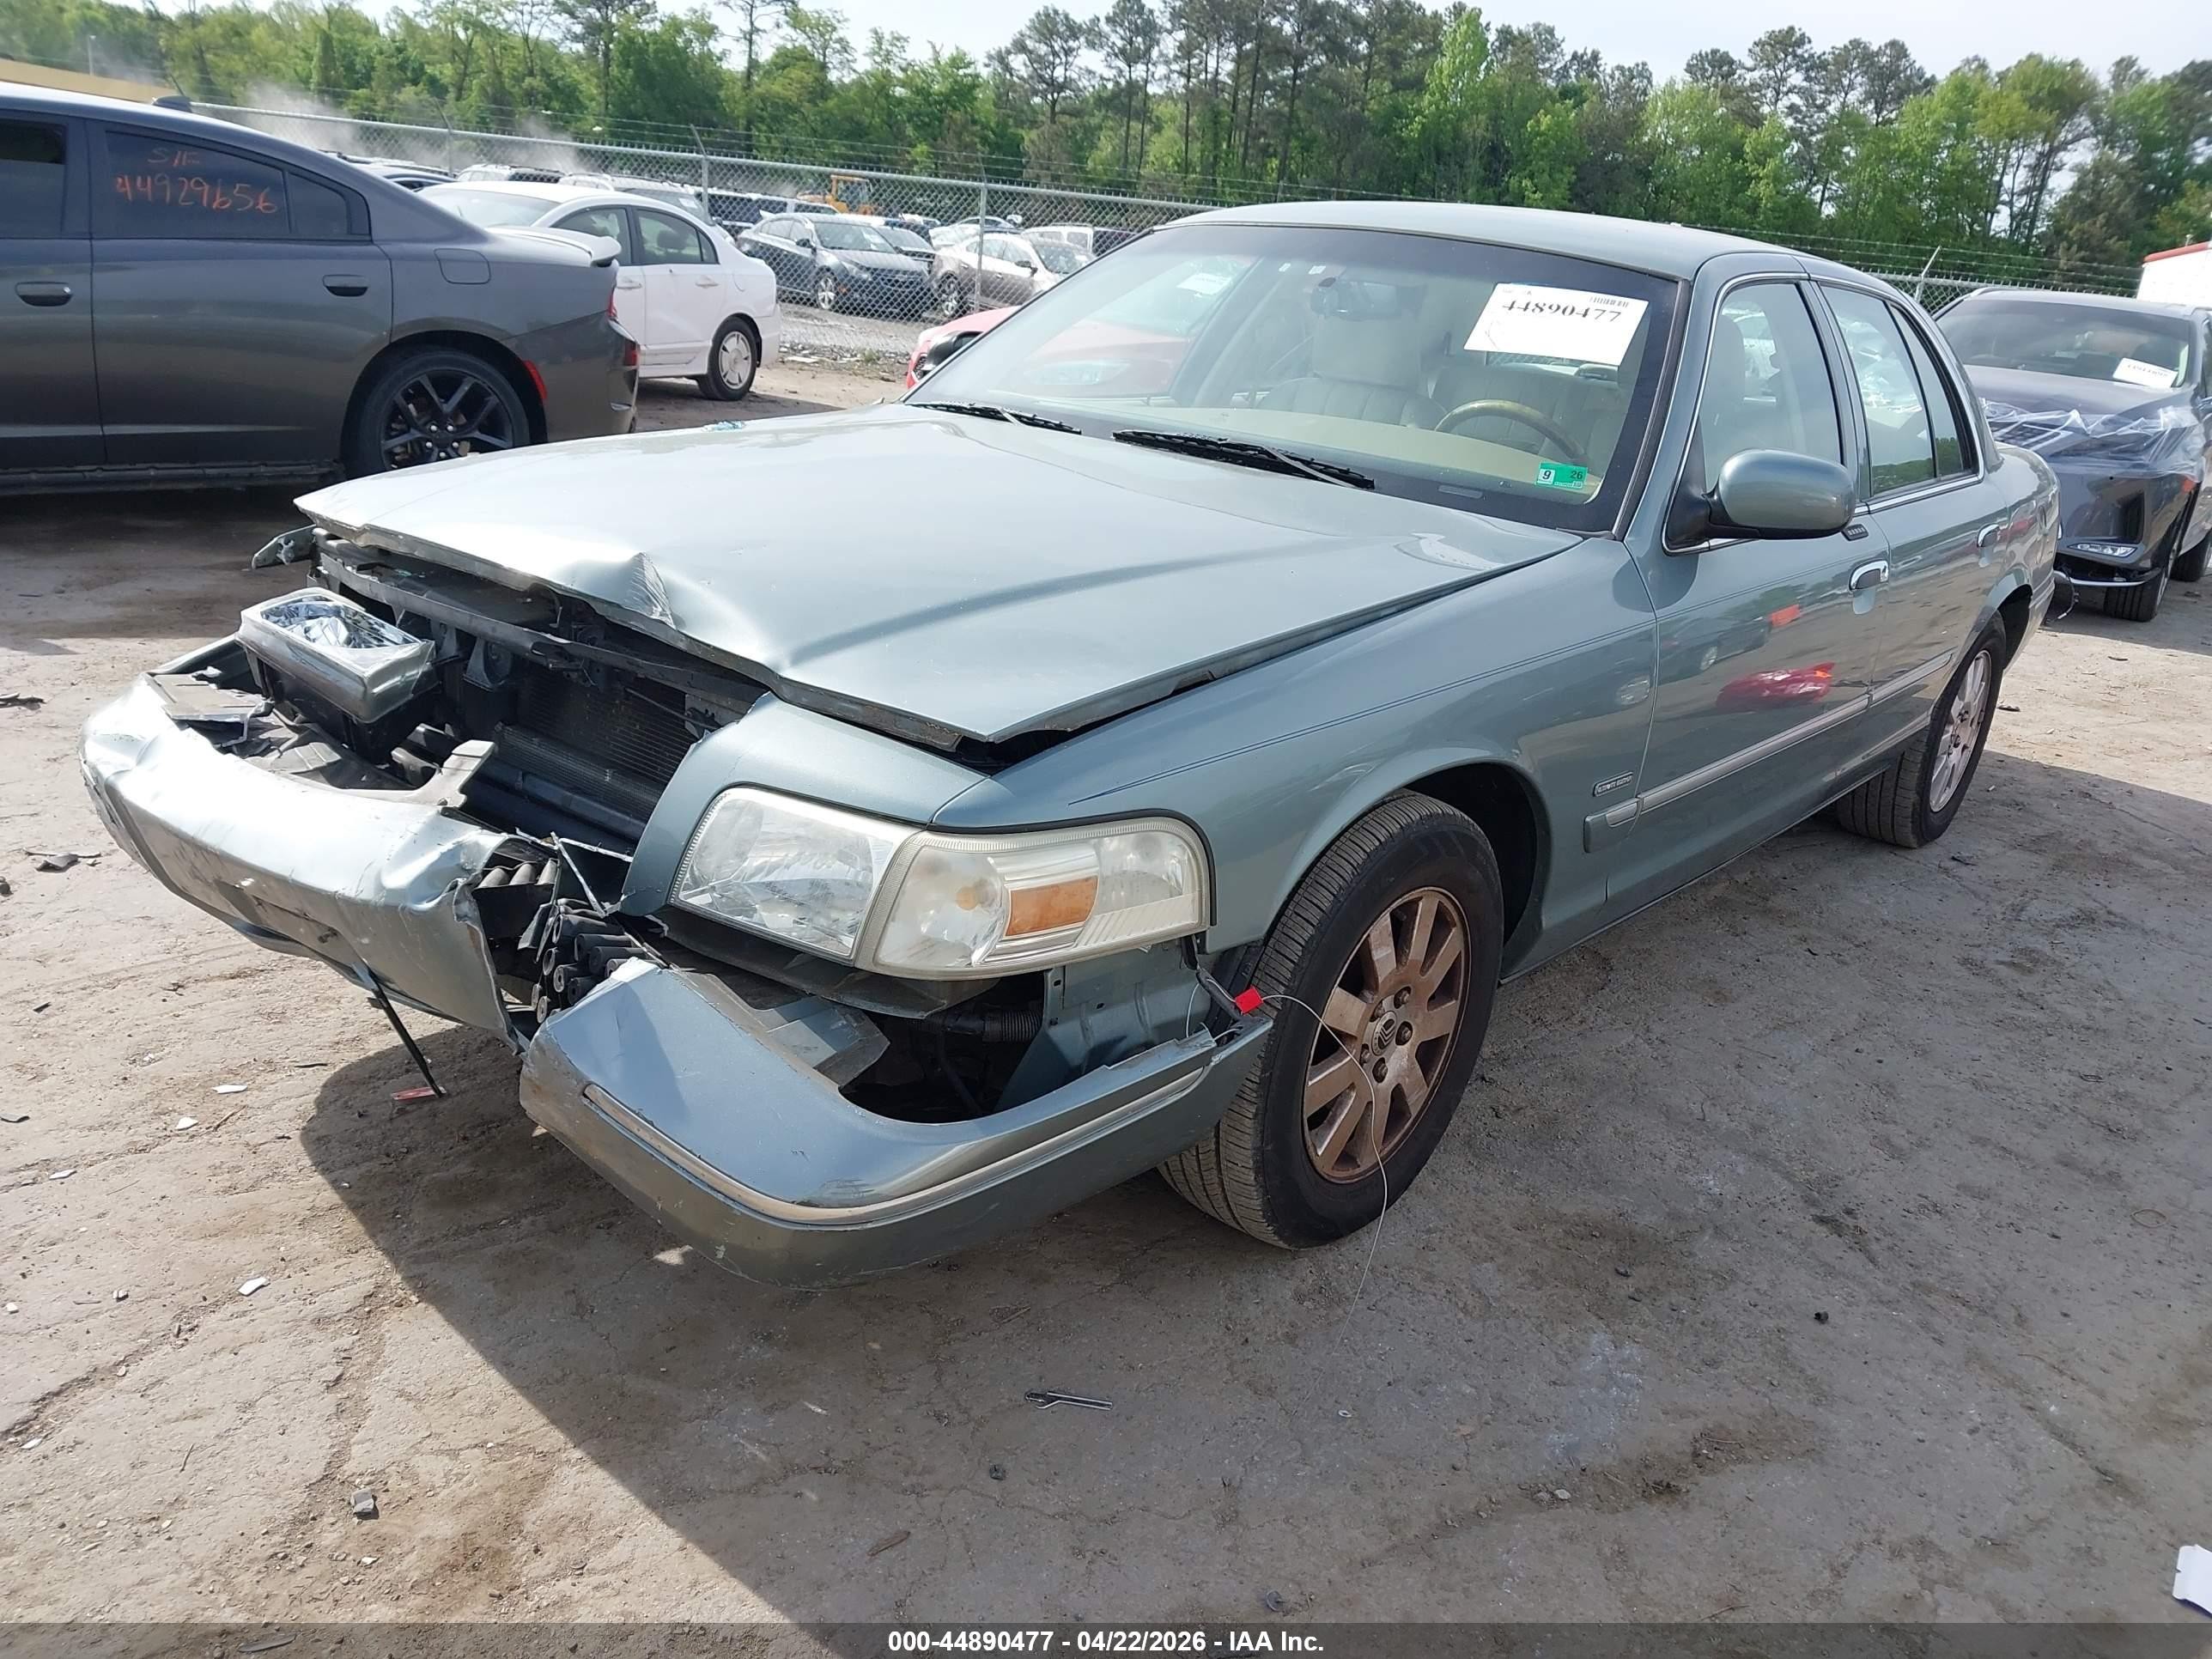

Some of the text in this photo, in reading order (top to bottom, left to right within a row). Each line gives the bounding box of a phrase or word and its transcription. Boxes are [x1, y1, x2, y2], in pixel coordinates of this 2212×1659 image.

[116, 173, 277, 213] 44929656
[1502, 301, 1621, 322] 44890477
[1542, 470, 1552, 480] 9
[1571, 470, 1583, 479] 26
